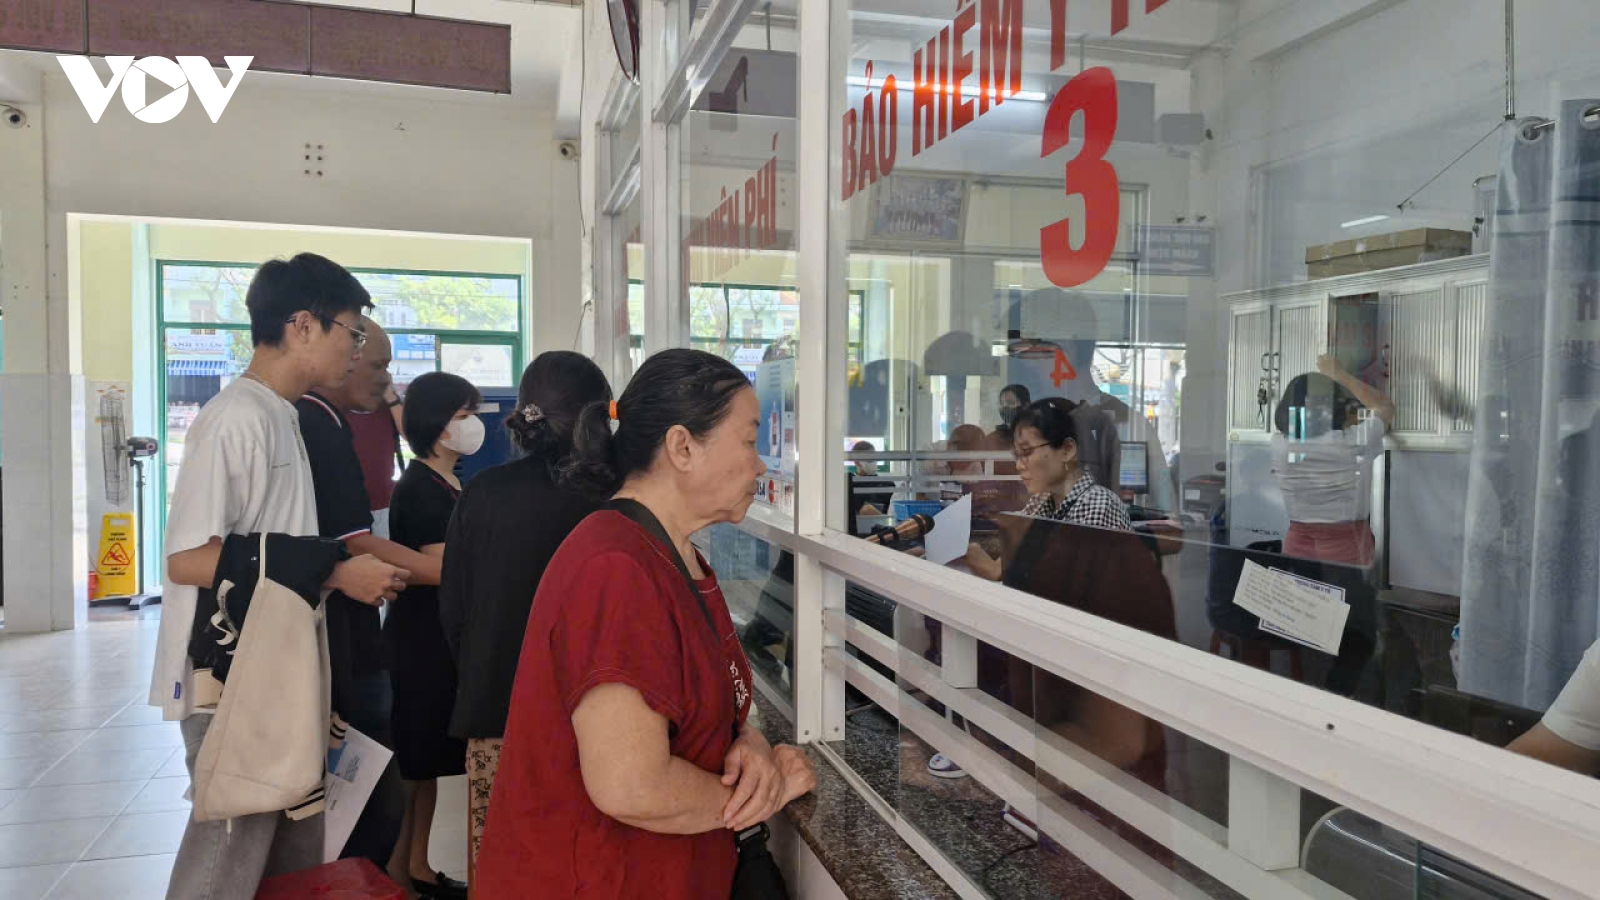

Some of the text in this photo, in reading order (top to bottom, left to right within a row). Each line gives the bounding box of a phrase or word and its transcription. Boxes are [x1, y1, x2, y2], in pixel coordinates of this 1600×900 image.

[744, 131, 777, 260] PHÍ
[842, 60, 897, 201] BẢO
[1040, 66, 1120, 288] 3
